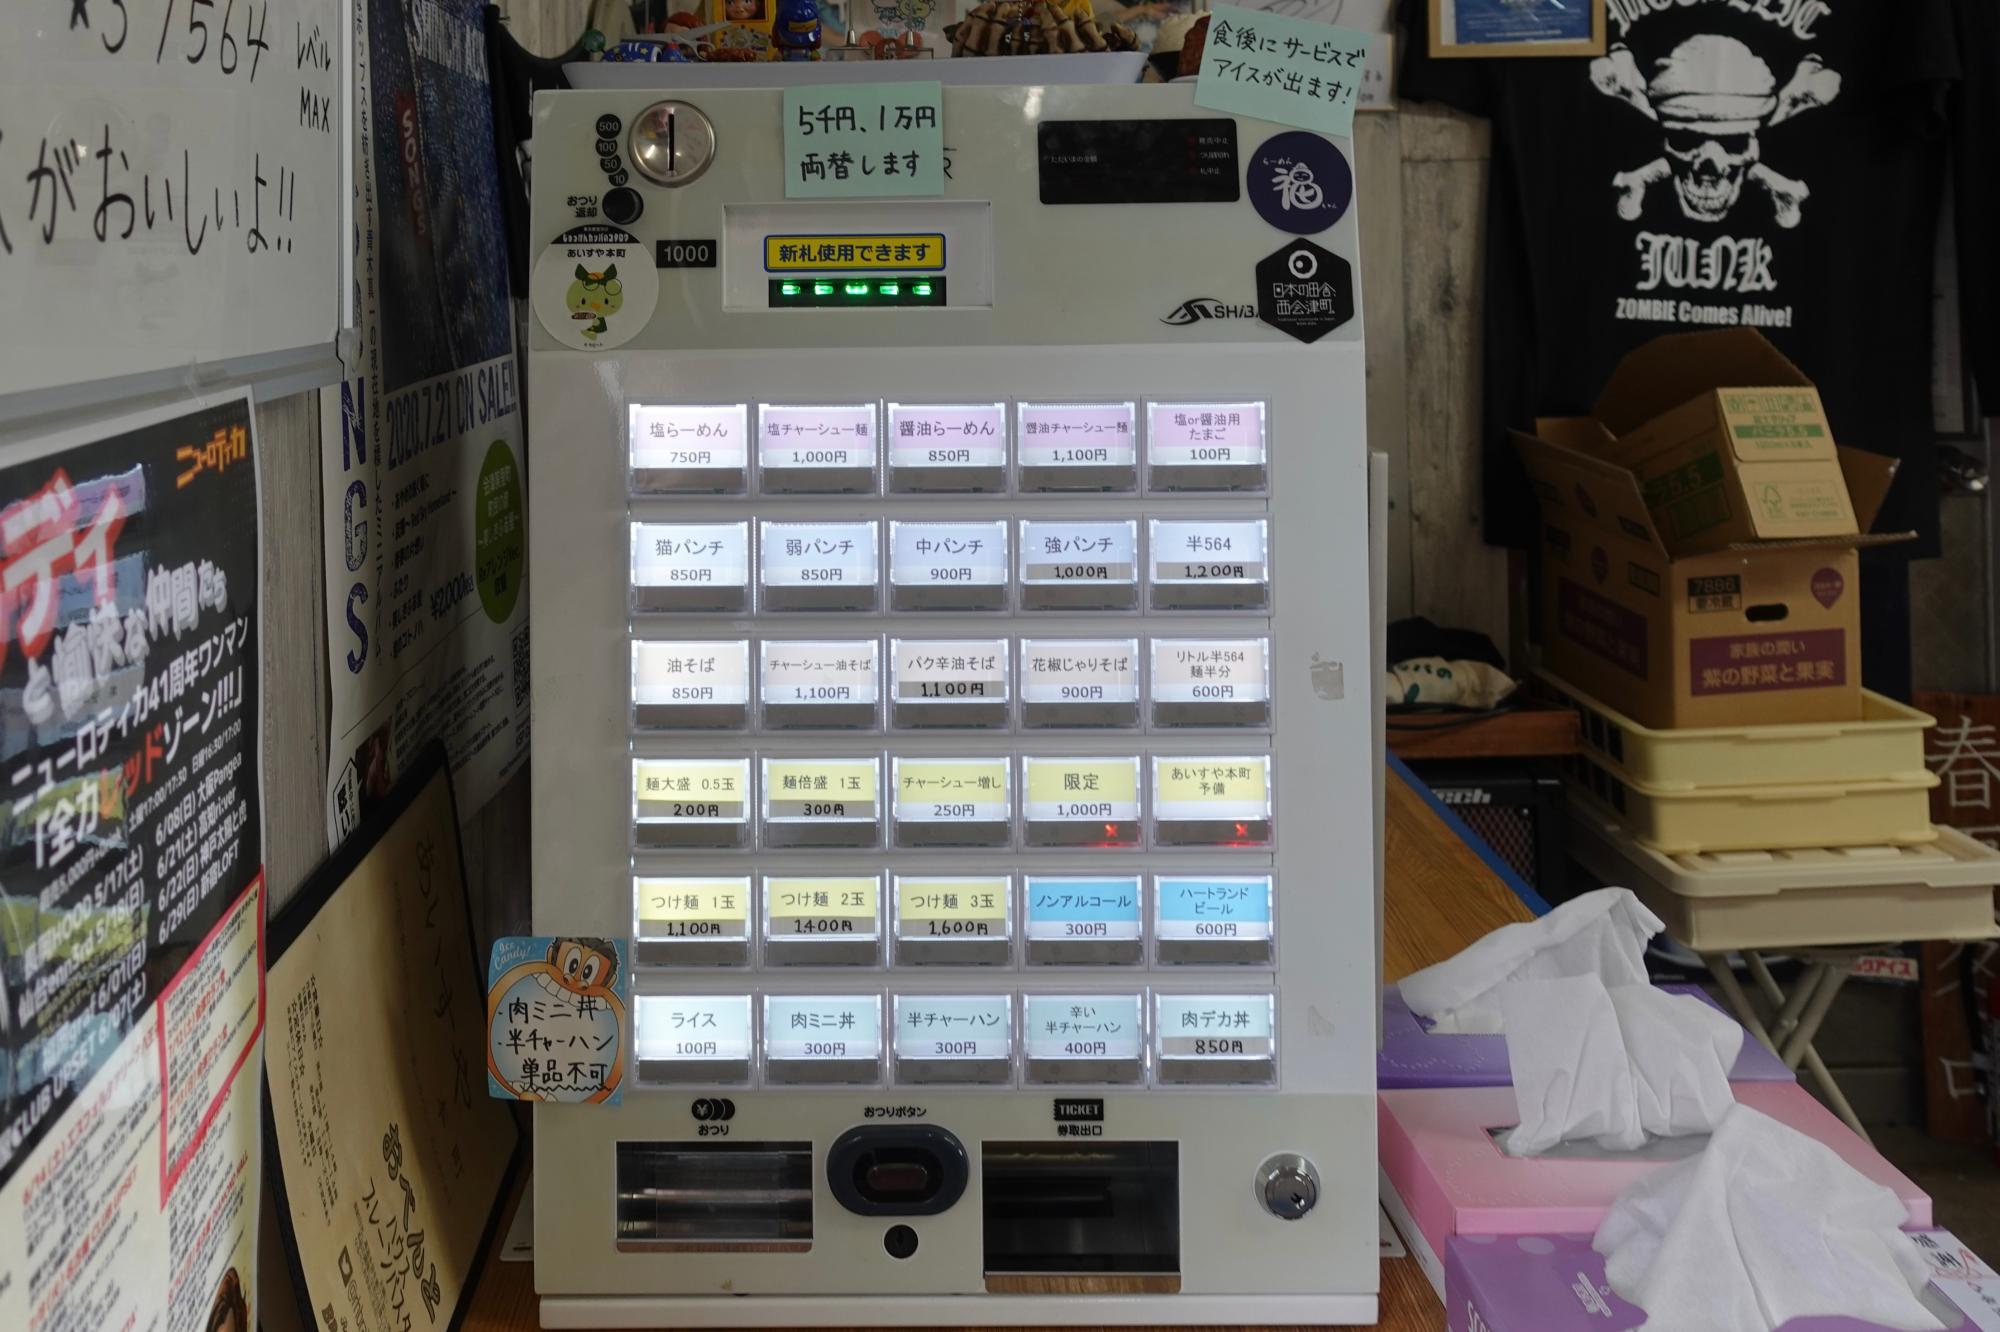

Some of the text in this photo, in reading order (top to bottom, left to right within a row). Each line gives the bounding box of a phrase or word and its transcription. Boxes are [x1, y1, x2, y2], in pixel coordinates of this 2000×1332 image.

[1212, 19, 1366, 68] 食後にサービスで
[1212, 57, 1353, 104] アイスが出ます!
[300, 86, 330, 133] MAX
[599, 121, 619, 131] 500
[800, 105, 936, 136] 5千円、1万円
[599, 142, 616, 152] 100
[604, 160, 618, 169] 50
[801, 149, 921, 181] 両替します
[401, 108, 428, 236] SONGS
[613, 175, 625, 185] 10
[567, 195, 598, 207] おつり
[575, 207, 598, 218] 返却
[567, 248, 626, 258] あいすや本町
[663, 245, 709, 261] 1000
[779, 244, 931, 262] 新札使用できます
[1615, 297, 1793, 328] ZOMBIE Comes Alive!
[457, 376, 477, 431] ON
[648, 421, 728, 439] 塩らーめん
[899, 420, 996, 437] 醤油らーめん
[1189, 427, 1226, 441] たまご
[670, 451, 711, 464] 750円
[792, 450, 847, 464] 1,000円
[927, 450, 970, 463] 850円
[1052, 449, 1108, 463] 1,100円
[1190, 448, 1231, 461] 100円
[655, 538, 724, 556] 猫パンチ
[785, 538, 855, 556] 弱パンチ
[916, 537, 984, 555] 中パンチ
[1044, 535, 1114, 555] 強パンチ
[1186, 535, 1232, 552] 半564
[670, 568, 712, 581] 850円
[801, 568, 843, 581] 850円
[930, 567, 972, 581] 900円
[1054, 565, 1108, 580] 1,000円
[1184, 564, 1244, 579] 1,200円
[1176, 650, 1245, 664] リトル半564
[667, 657, 716, 674] 油そば
[769, 658, 871, 671] チャーシュー油そば
[1032, 657, 1128, 673] 花椒じゃりそば
[1189, 665, 1231, 679] 麺半分
[671, 686, 713, 700] 850円
[794, 686, 850, 700] 1,100円
[920, 682, 984, 697] 1,100円
[1061, 686, 1103, 699] 900円
[1192, 685, 1234, 698] 600円
[1171, 767, 1250, 781] あいすや本町
[645, 776, 735, 791] 麺大盛 0.5玉
[782, 775, 862, 790] 麺倍盛 1玉
[903, 775, 1001, 789] チャーシュー増し
[1064, 773, 1099, 791] 限定
[1199, 782, 1225, 796] 予備
[673, 804, 720, 817] 200円
[803, 803, 845, 817] 300円
[933, 804, 976, 817] 250円
[1056, 803, 1113, 816] 1,000円
[781, 891, 865, 907] つけ麺 2玉
[1180, 887, 1249, 899] ハートランド
[651, 894, 736, 910] つけ麺 1玉
[910, 894, 995, 910] つけ麺 3玉
[1036, 895, 1132, 908] ノンアルコール
[1194, 902, 1234, 915] ビール
[667, 921, 721, 936] 1,100円
[928, 920, 989, 936] 1,600円
[1065, 923, 1107, 936] 300円
[1195, 923, 1237, 937] 600円
[1070, 1006, 1096, 1018] 辛い
[1181, 1010, 1250, 1028] 肉デカ丼
[671, 1012, 717, 1029] ライス
[790, 1011, 856, 1029] 肉ミニ丼
[907, 1012, 1000, 1028] 半チャーハン
[1045, 1021, 1122, 1034] 半チャーハン
[676, 1042, 717, 1054] 100円
[804, 1042, 846, 1055] 300円
[935, 1042, 977, 1055] 300円
[1064, 1042, 1107, 1055] 400円
[1194, 1039, 1243, 1054] 850円
[520, 1057, 608, 1088] 単品不可
[863, 1106, 927, 1118] おつりボタン
[1058, 1103, 1100, 1116] TICKET
[698, 1124, 730, 1136] おつり
